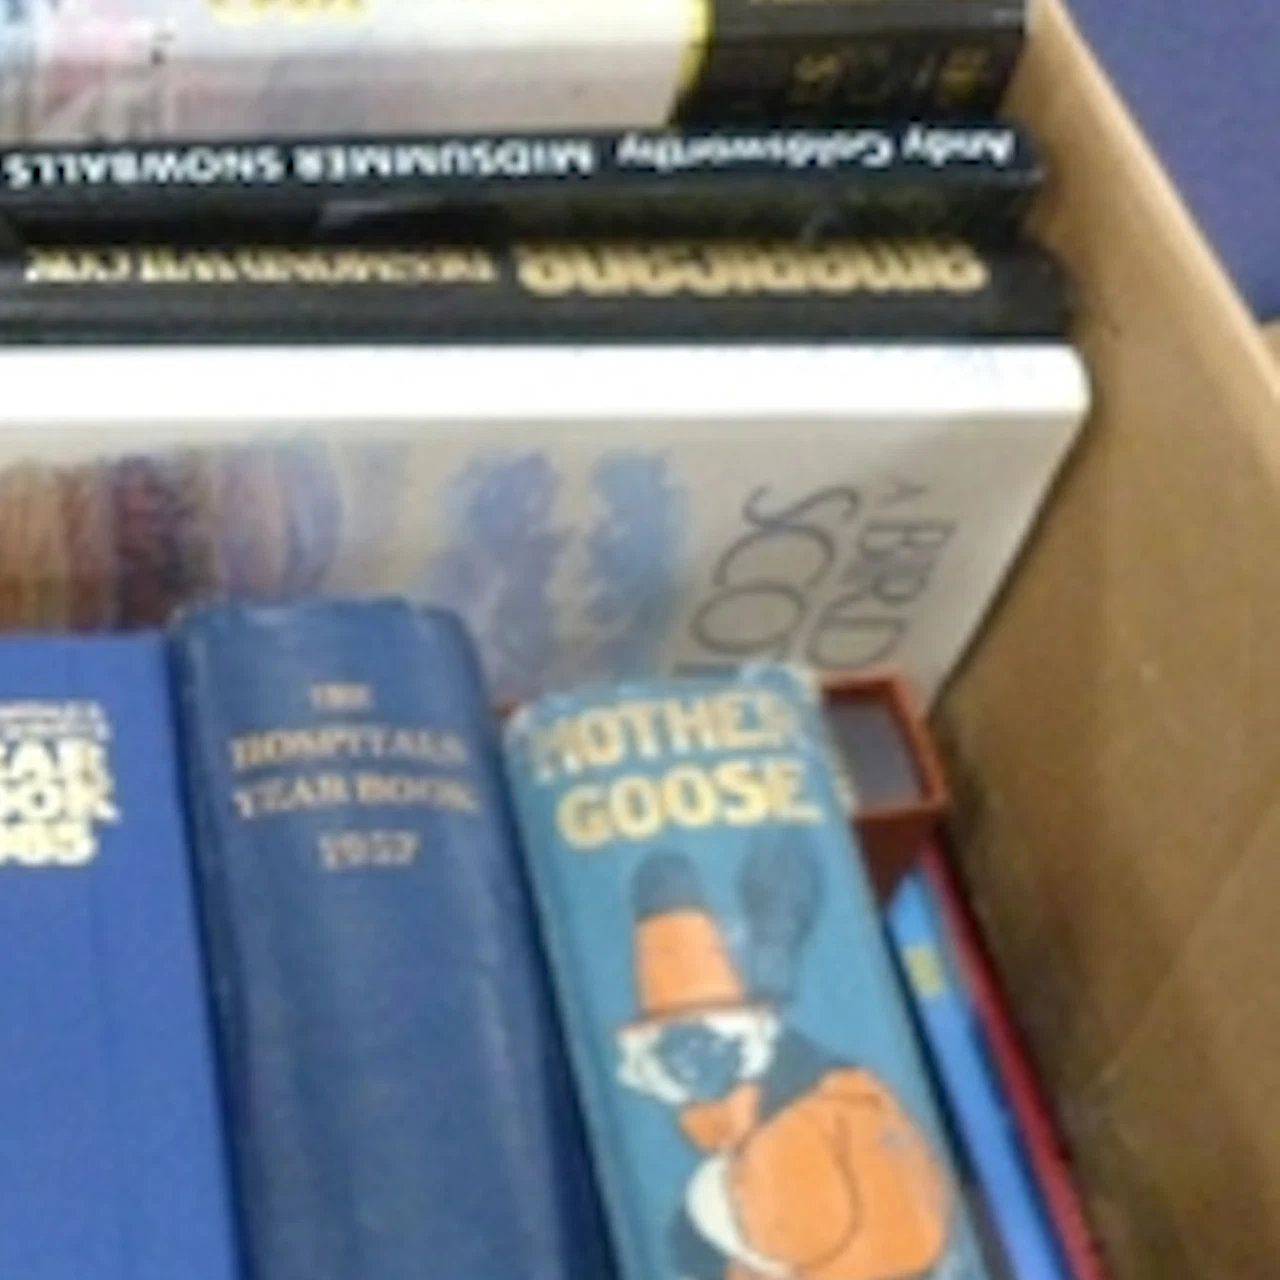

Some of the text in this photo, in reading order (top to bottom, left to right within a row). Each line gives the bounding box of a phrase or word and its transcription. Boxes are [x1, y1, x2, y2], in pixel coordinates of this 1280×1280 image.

[2, 125, 1016, 190] Andy Goldsworthy MIDSUMMER SNOWBALLS
[689, 482, 864, 665] SCO
[804, 517, 960, 671] BIRD
[557, 756, 823, 851] GOOSE
